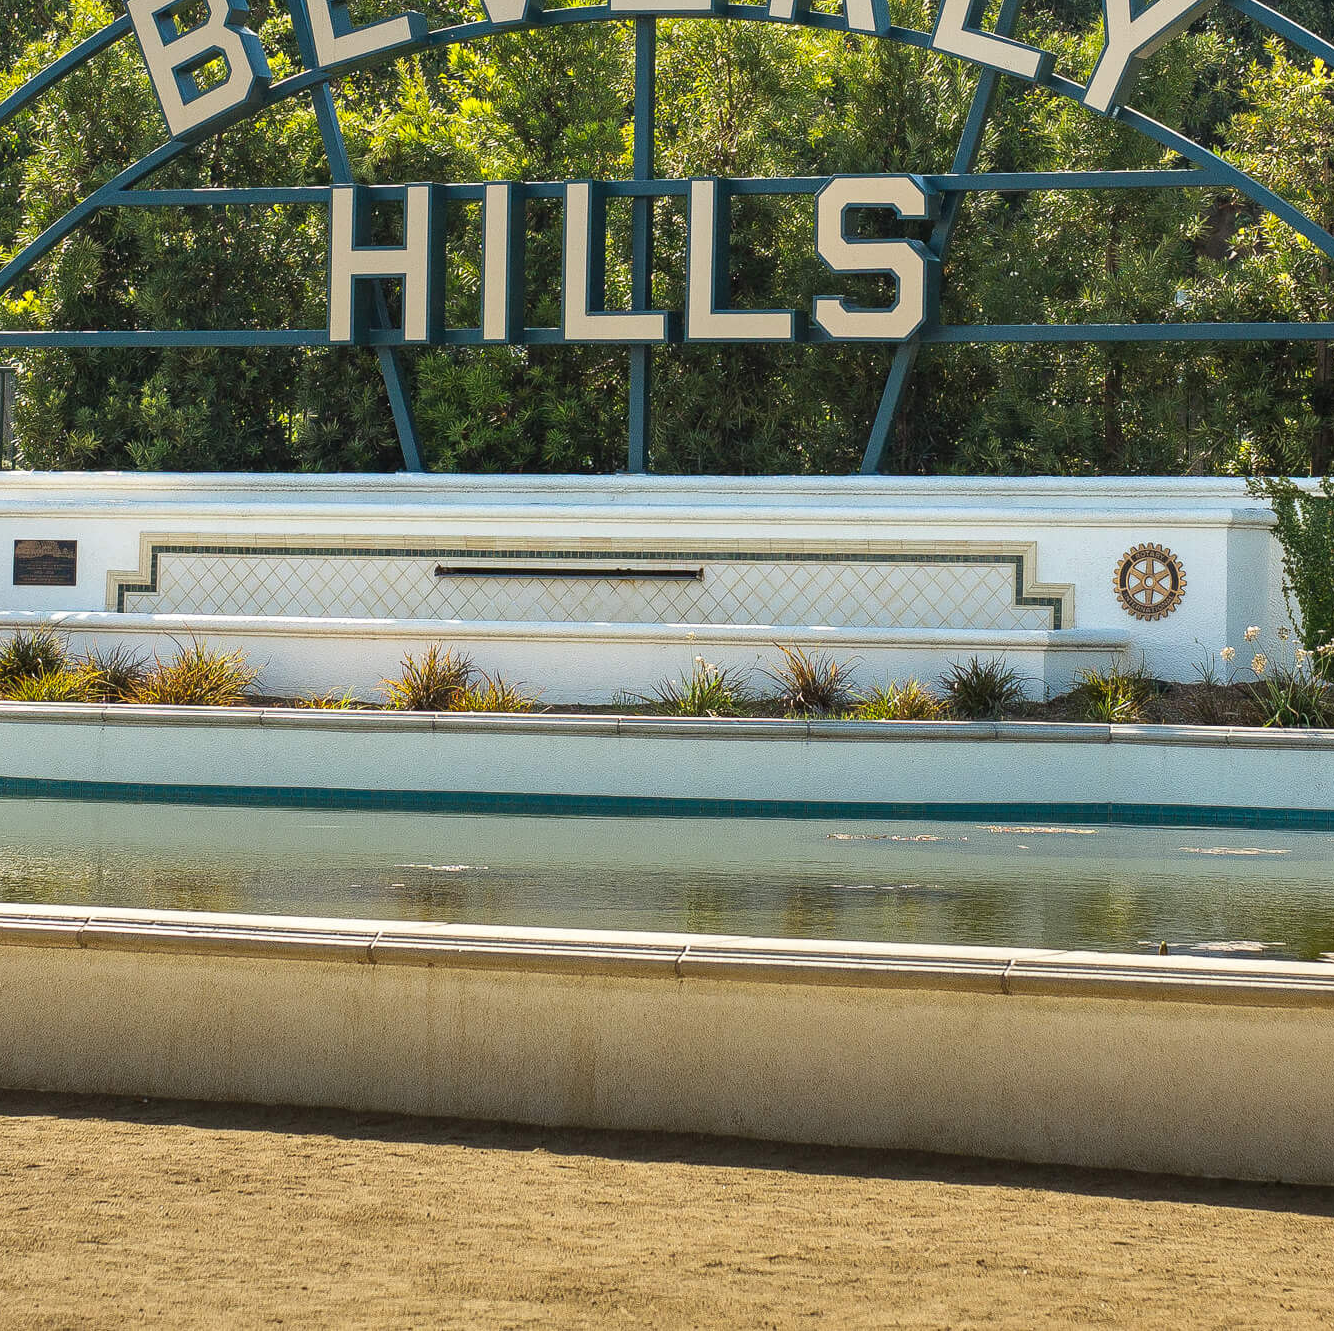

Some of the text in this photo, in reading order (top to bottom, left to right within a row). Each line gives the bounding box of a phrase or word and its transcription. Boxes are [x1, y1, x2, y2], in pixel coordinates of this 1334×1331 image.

[328, 173, 940, 344] HILLS
[1135, 550, 1165, 562] ROTARY
[1123, 591, 1174, 614] INTERNATIONAL
